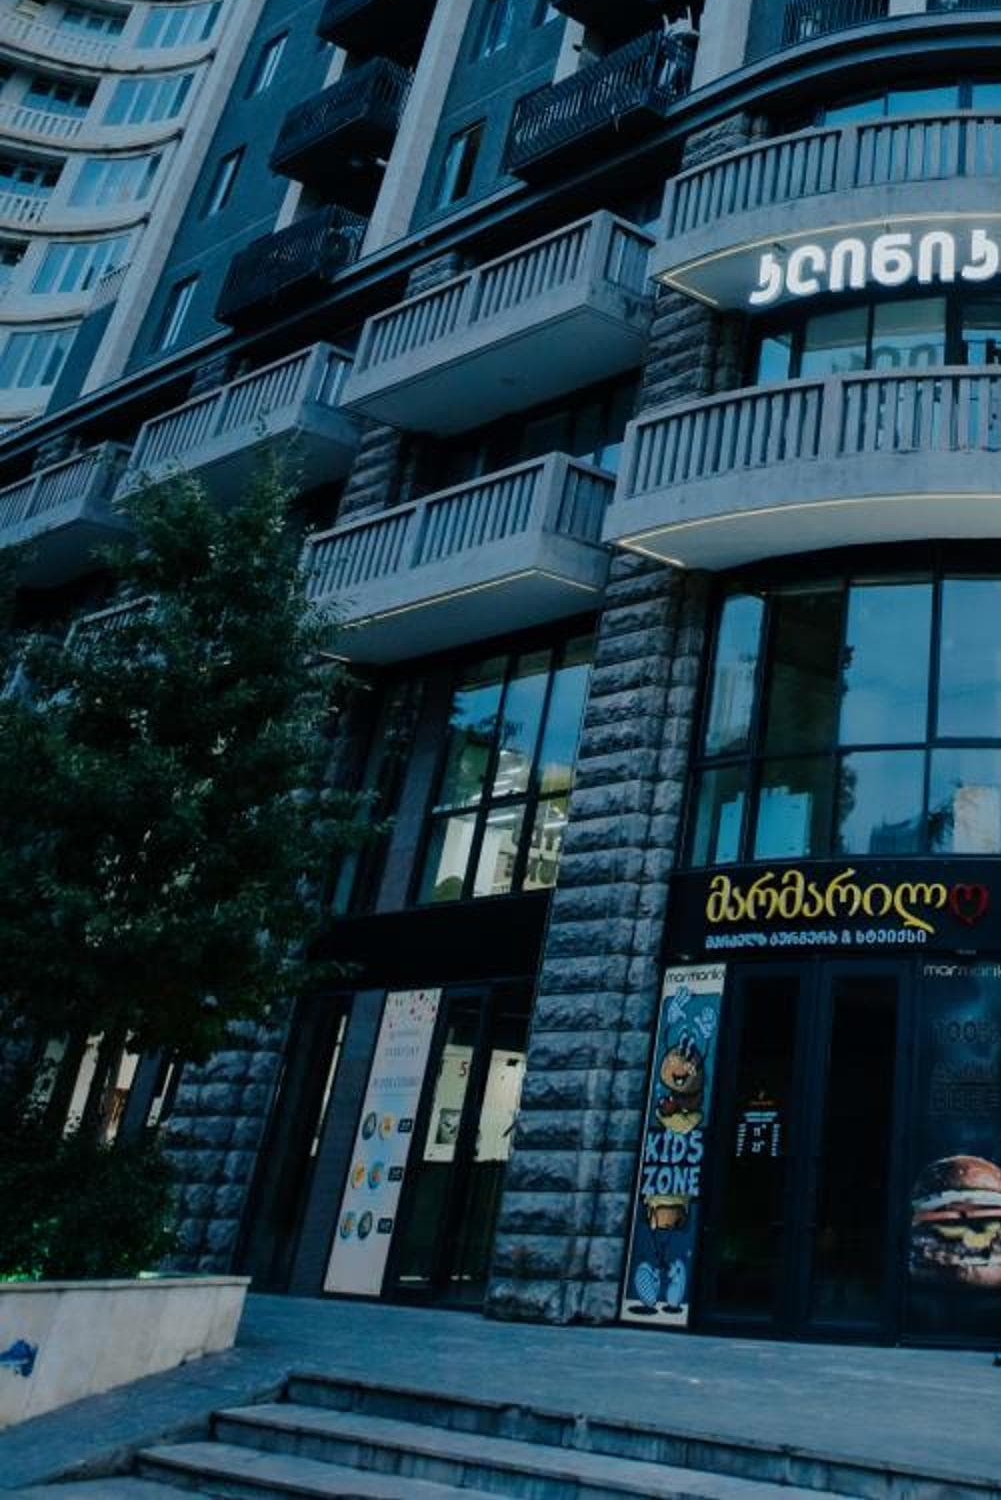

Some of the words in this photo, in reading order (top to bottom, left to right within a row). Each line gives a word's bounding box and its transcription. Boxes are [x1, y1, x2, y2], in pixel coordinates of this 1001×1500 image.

[841, 928, 851, 944] &
[645, 1129, 704, 1164] KIDS
[641, 1165, 701, 1196] ZONE
